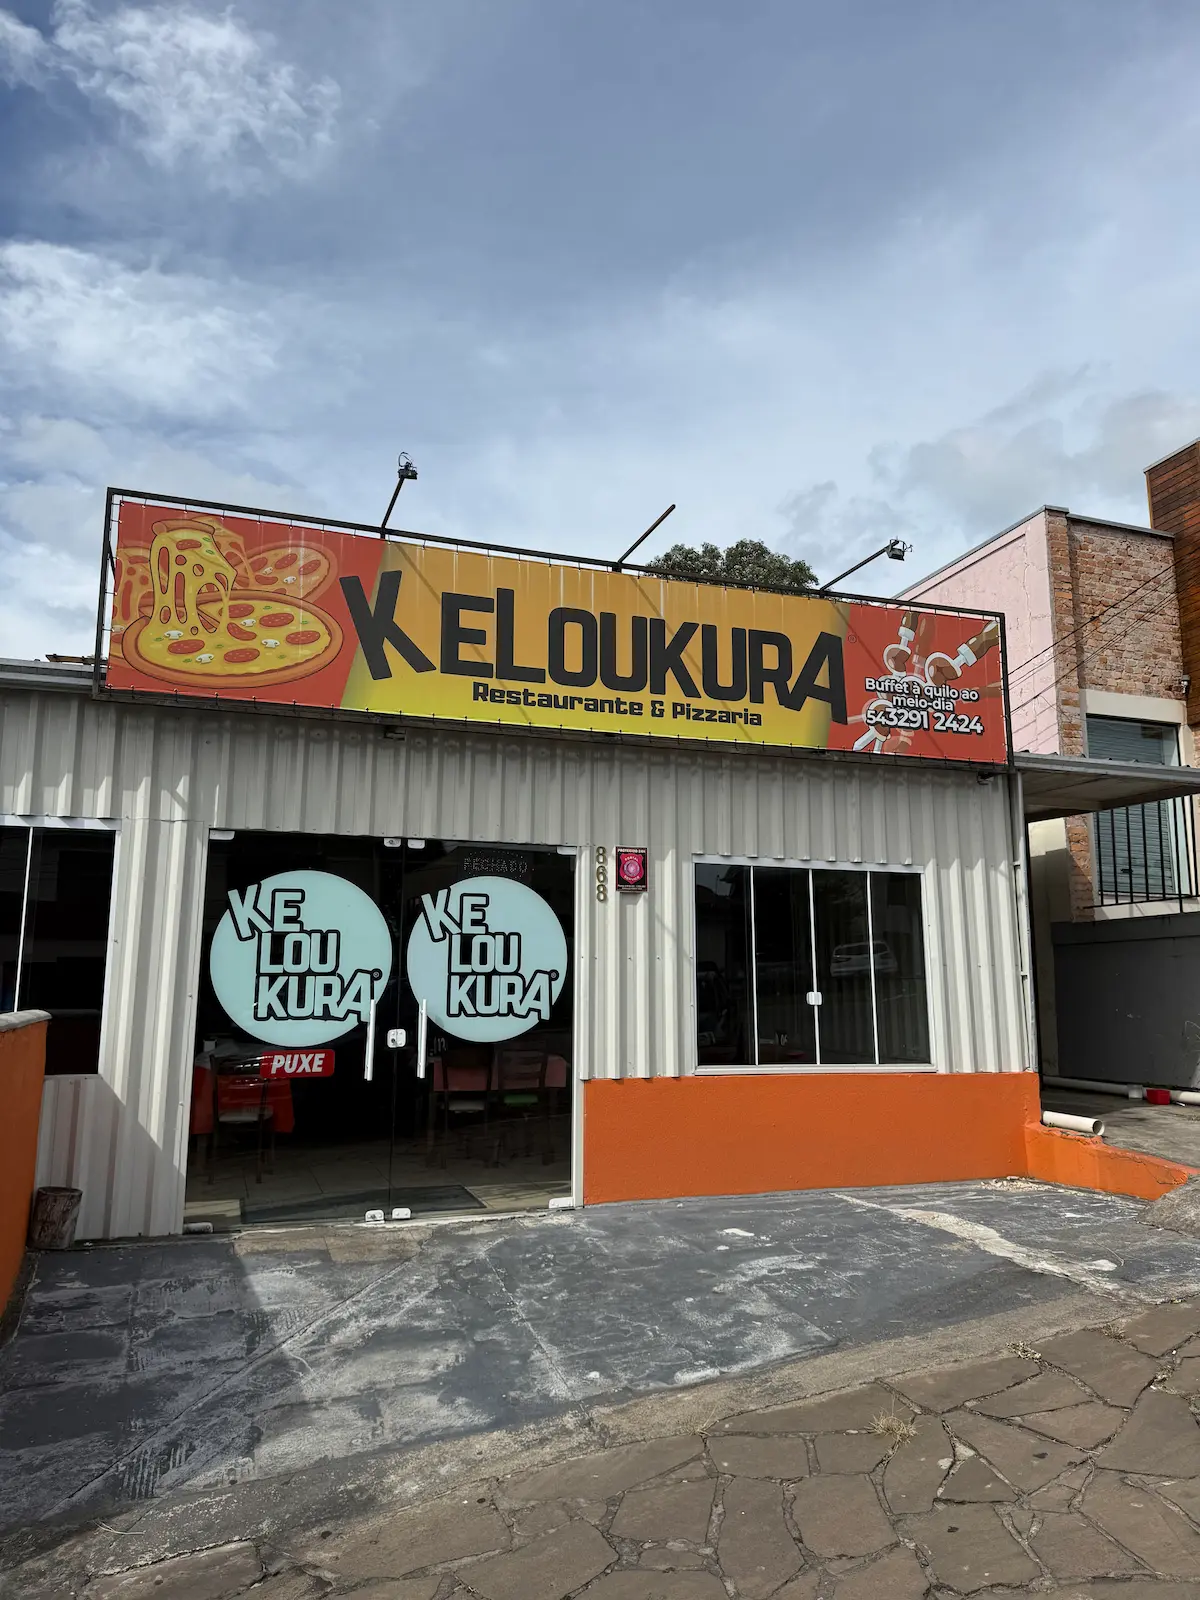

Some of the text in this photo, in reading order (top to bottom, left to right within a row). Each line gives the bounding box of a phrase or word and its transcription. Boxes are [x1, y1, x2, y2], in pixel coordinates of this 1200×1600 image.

[339, 570, 848, 726] KELOUKURA
[472, 681, 763, 727] Restaurante & Pizzaria
[865, 677, 979, 701] Buffet à quilo ao
[892, 694, 954, 711] meio-dia
[933, 712, 984, 734] 2424
[596, 846, 607, 902] 868
[228, 884, 302, 938] KE
[421, 889, 487, 940] KE
[260, 933, 338, 974] LOU
[451, 935, 519, 973] LOU
[271, 1053, 325, 1074] PUXE
